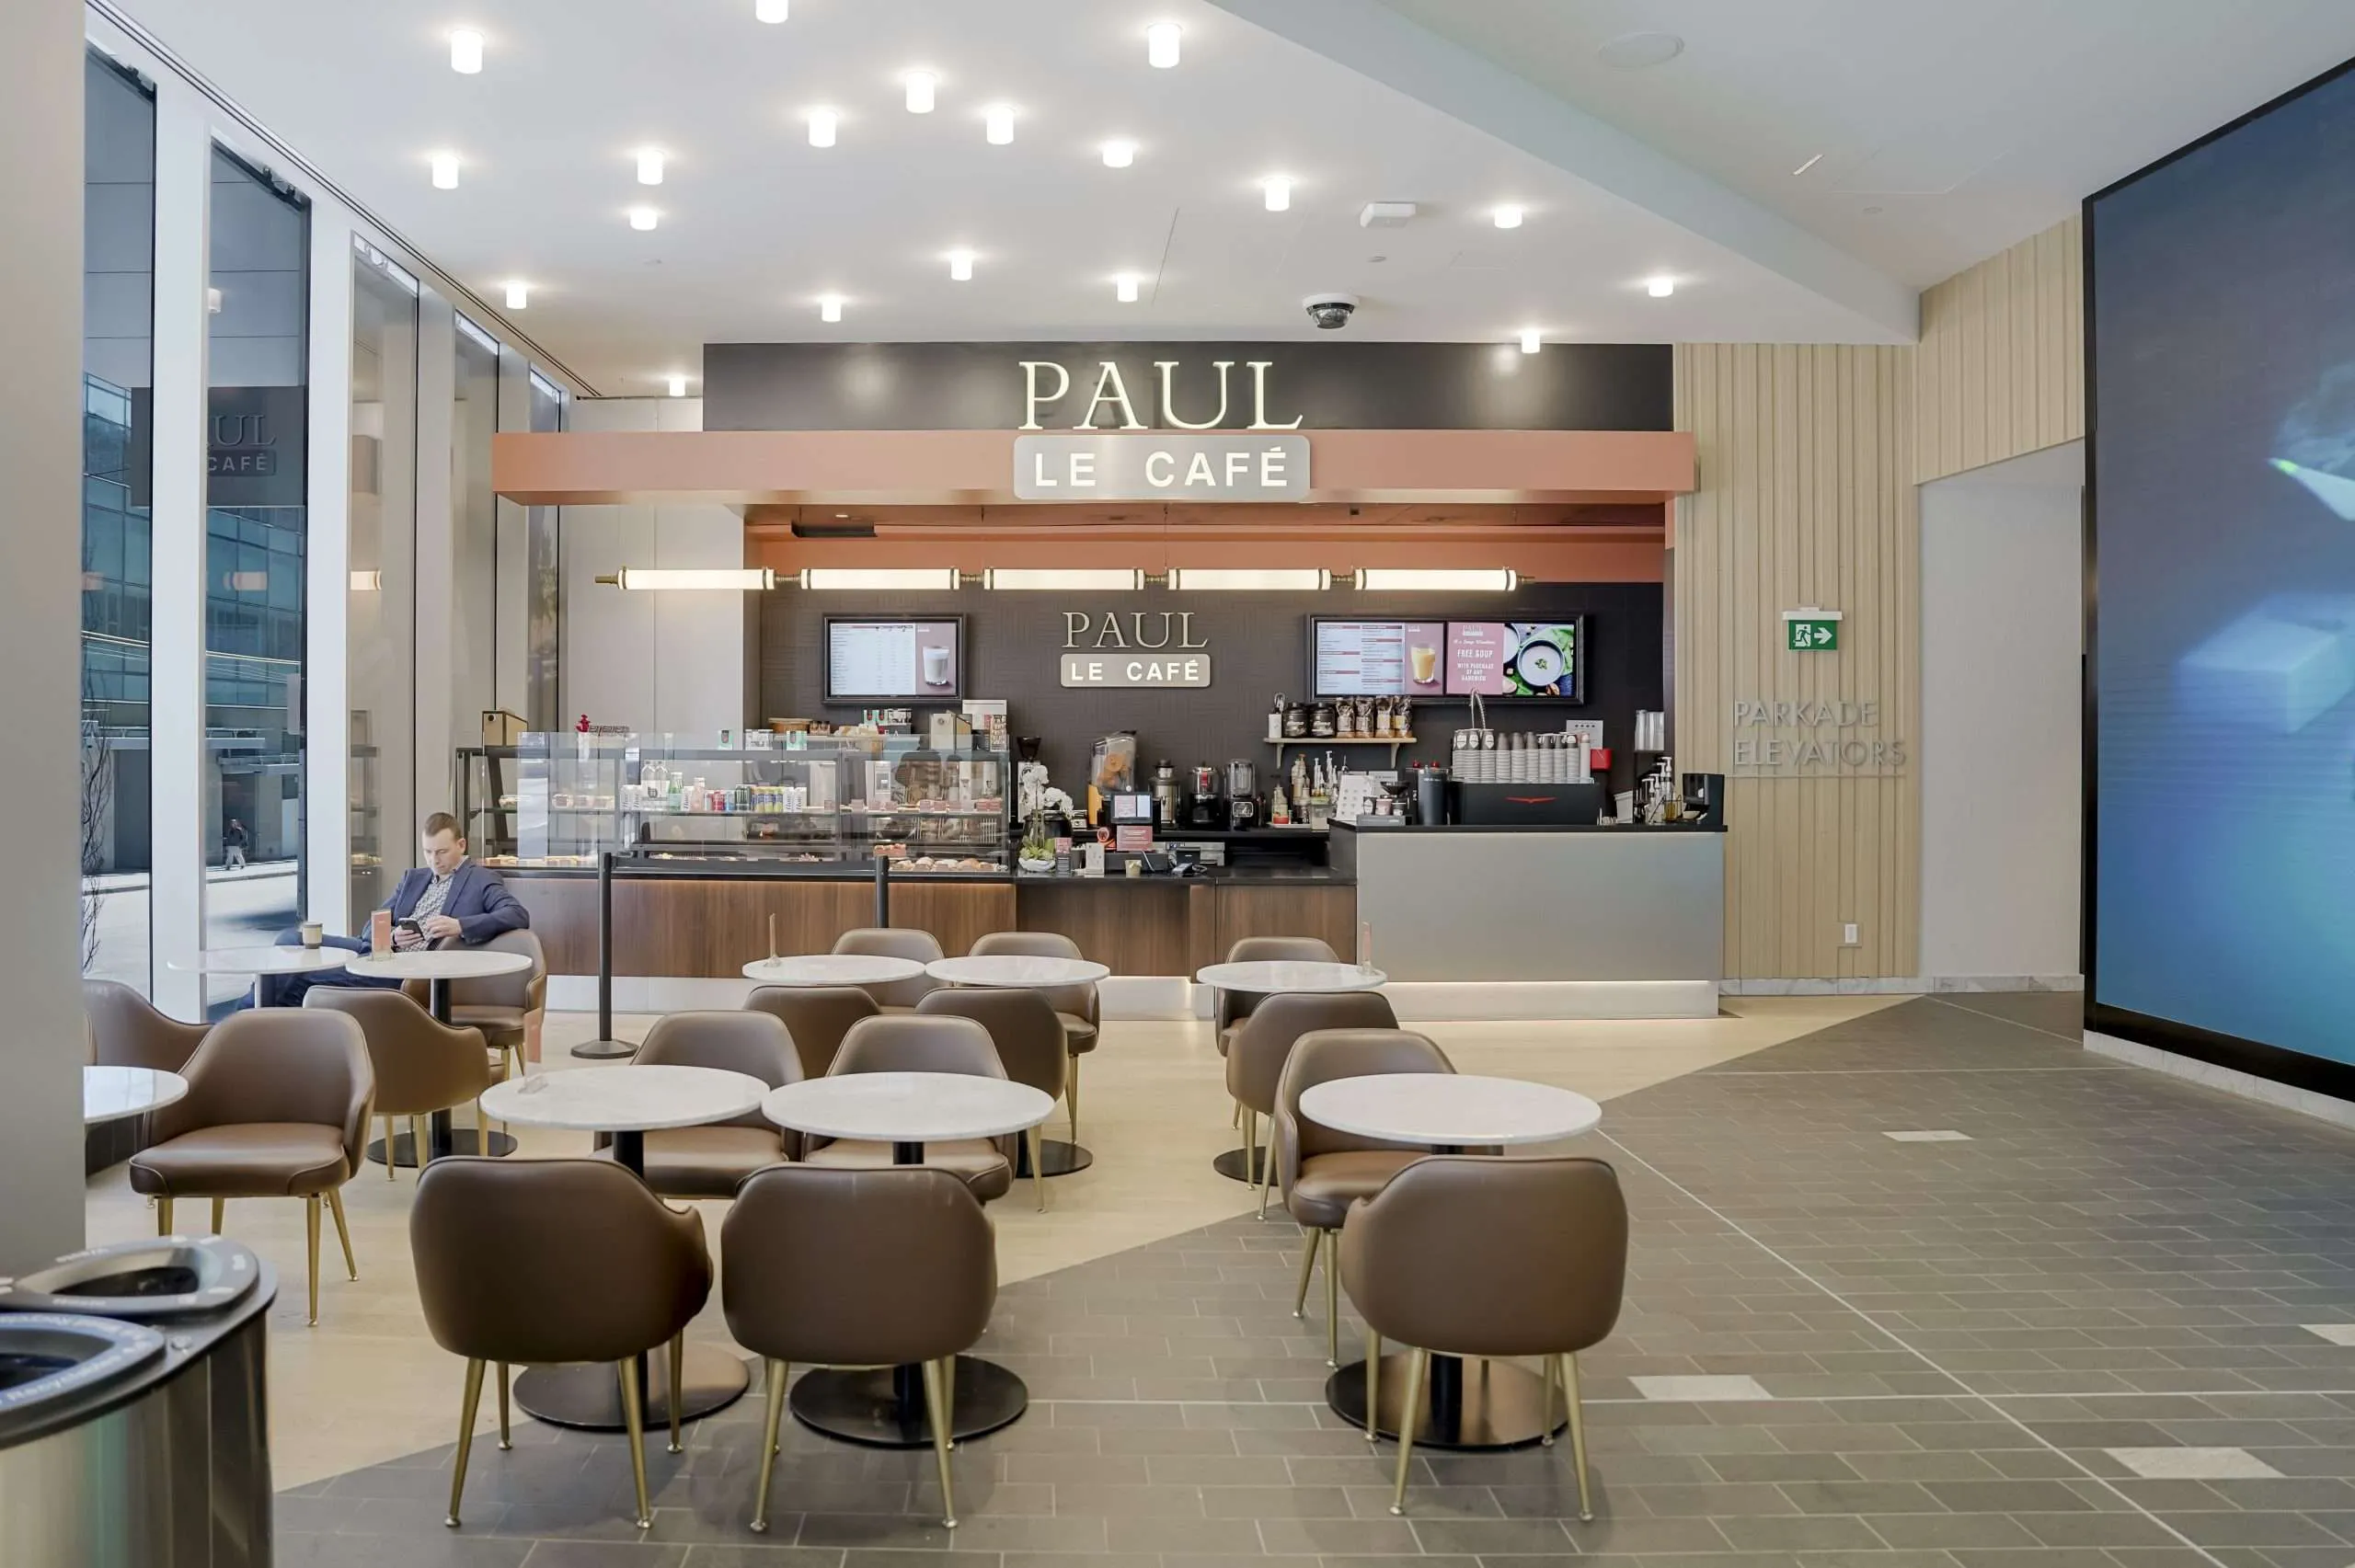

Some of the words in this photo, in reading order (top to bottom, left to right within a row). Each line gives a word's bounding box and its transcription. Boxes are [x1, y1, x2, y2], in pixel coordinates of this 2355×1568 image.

[1018, 361, 1304, 430] PAUL
[210, 414, 277, 447] UL
[1035, 452, 1097, 487] LE
[1145, 446, 1288, 488] CAFÉ
[1061, 612, 1209, 648] PAUL
[1071, 662, 1103, 681] LE
[1126, 659, 1200, 681] CAFÉ
[1733, 700, 1878, 728] PARKADE
[1734, 738, 1907, 767] ELEVATORS
